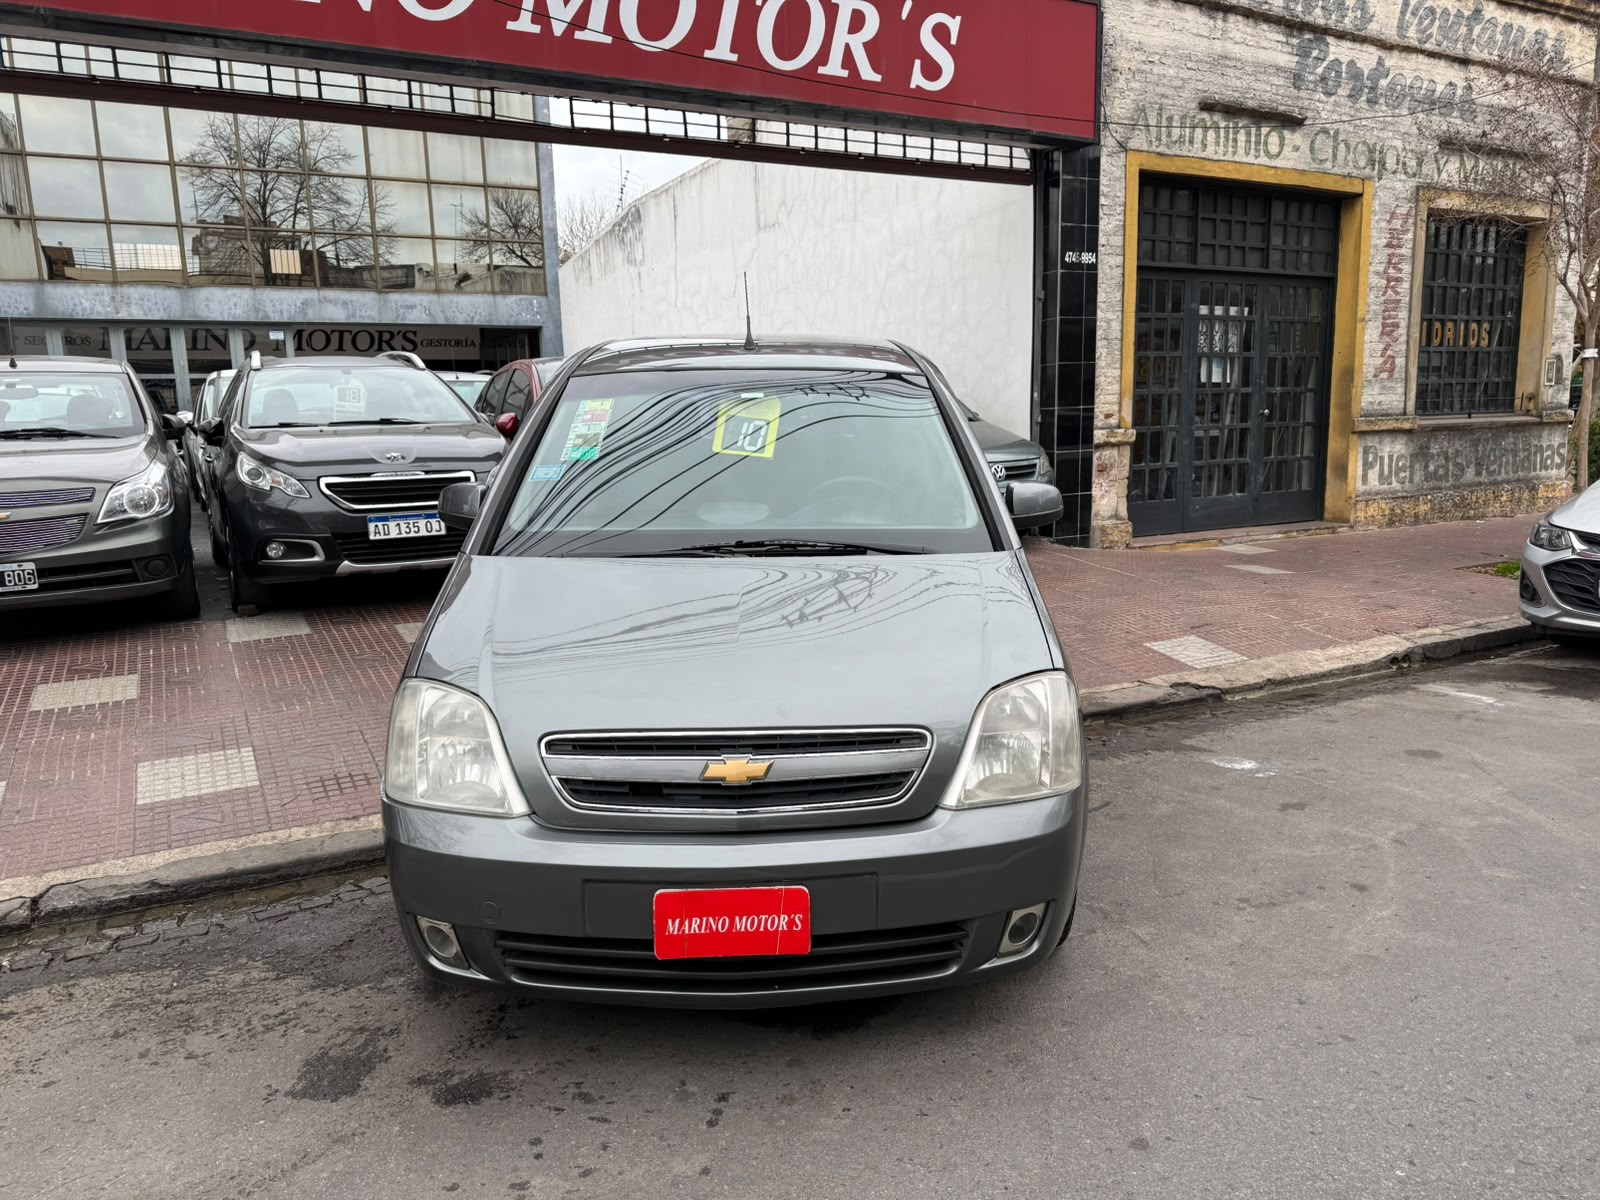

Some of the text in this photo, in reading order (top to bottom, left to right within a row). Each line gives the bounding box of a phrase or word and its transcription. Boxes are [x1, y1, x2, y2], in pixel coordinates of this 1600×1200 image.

[1137, 102, 1287, 160] Aluminio
[1309, 127, 1424, 182] Chapa
[1421, 320, 1490, 349] IDRIOS
[737, 420, 767, 451] 10
[1361, 441, 1567, 486] Puertas Ventanas
[373, 523, 391, 537] AD
[395, 521, 421, 536] 135
[4, 569, 34, 586] 806
[665, 914, 803, 936] MARINO MOTOR'S
